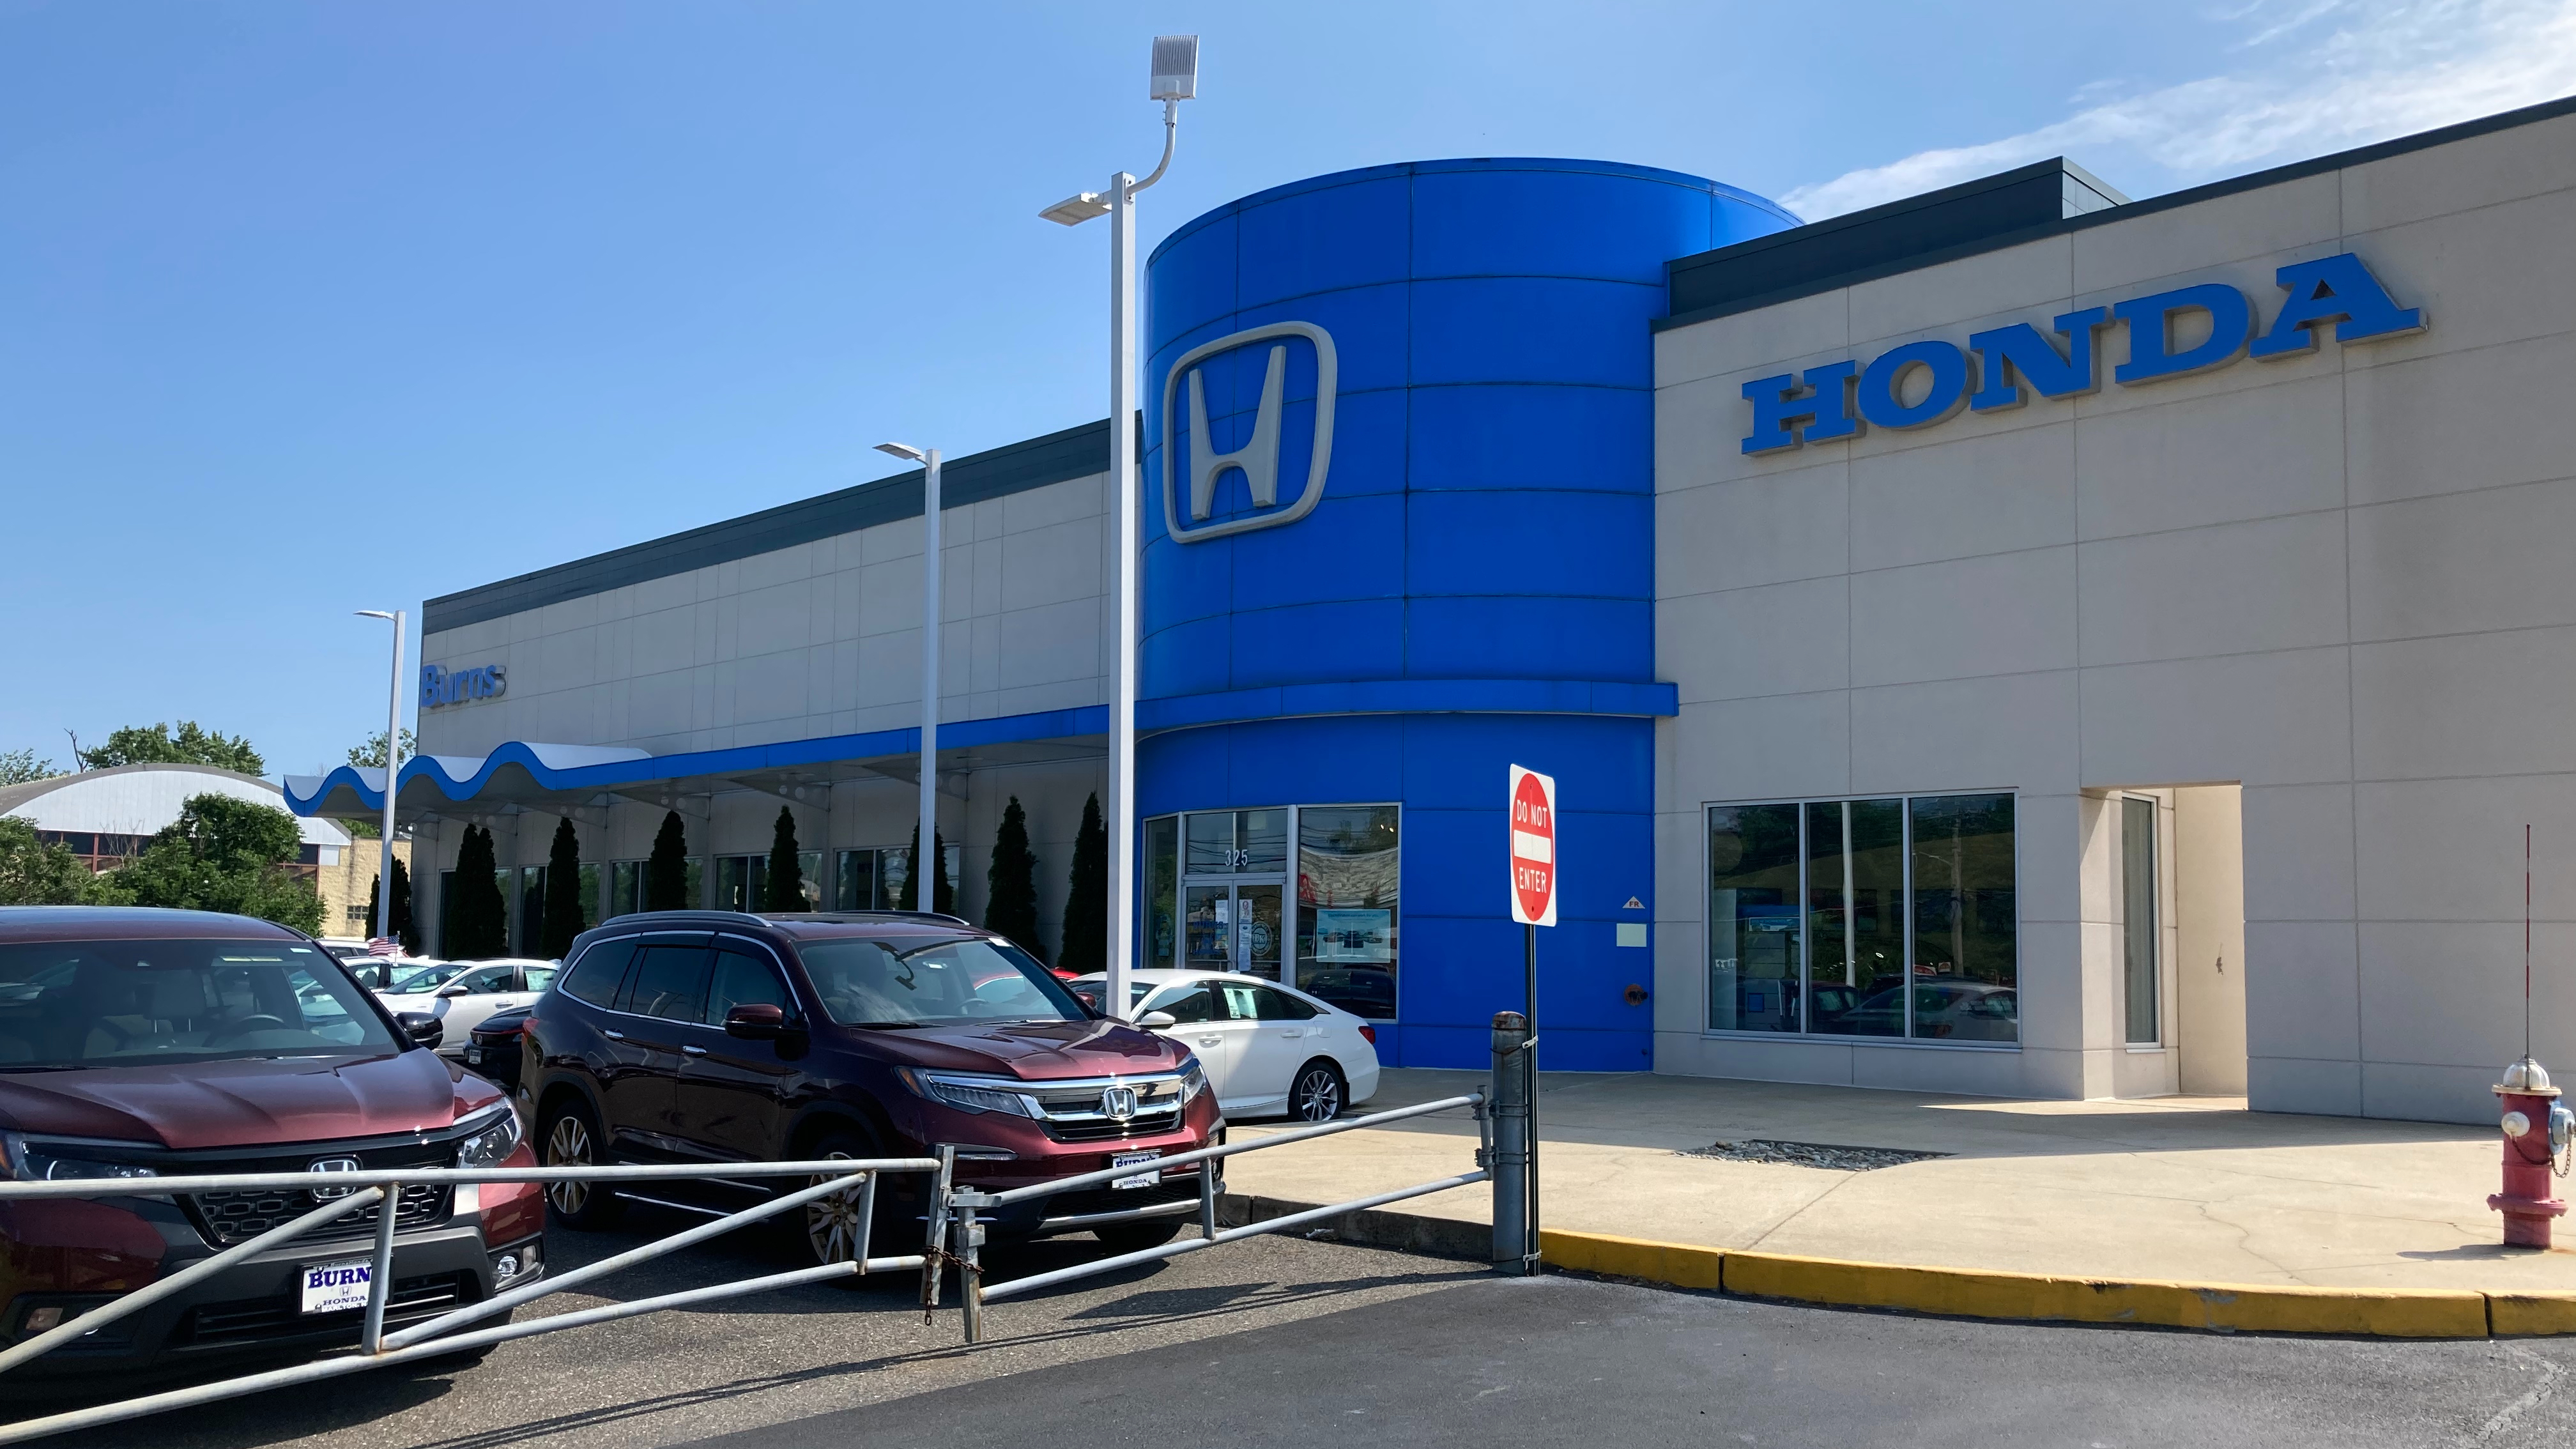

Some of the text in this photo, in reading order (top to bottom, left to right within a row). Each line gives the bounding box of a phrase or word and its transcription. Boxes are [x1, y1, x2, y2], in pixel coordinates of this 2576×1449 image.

[1742, 252, 2426, 456] HONDA
[420, 664, 506, 709] Burns
[1517, 799, 1548, 829] DO NOT
[1225, 849, 1248, 866] 325
[1519, 867, 1547, 894] ENTER
[308, 1266, 372, 1289] BURN
[323, 1296, 367, 1306] HONDA
